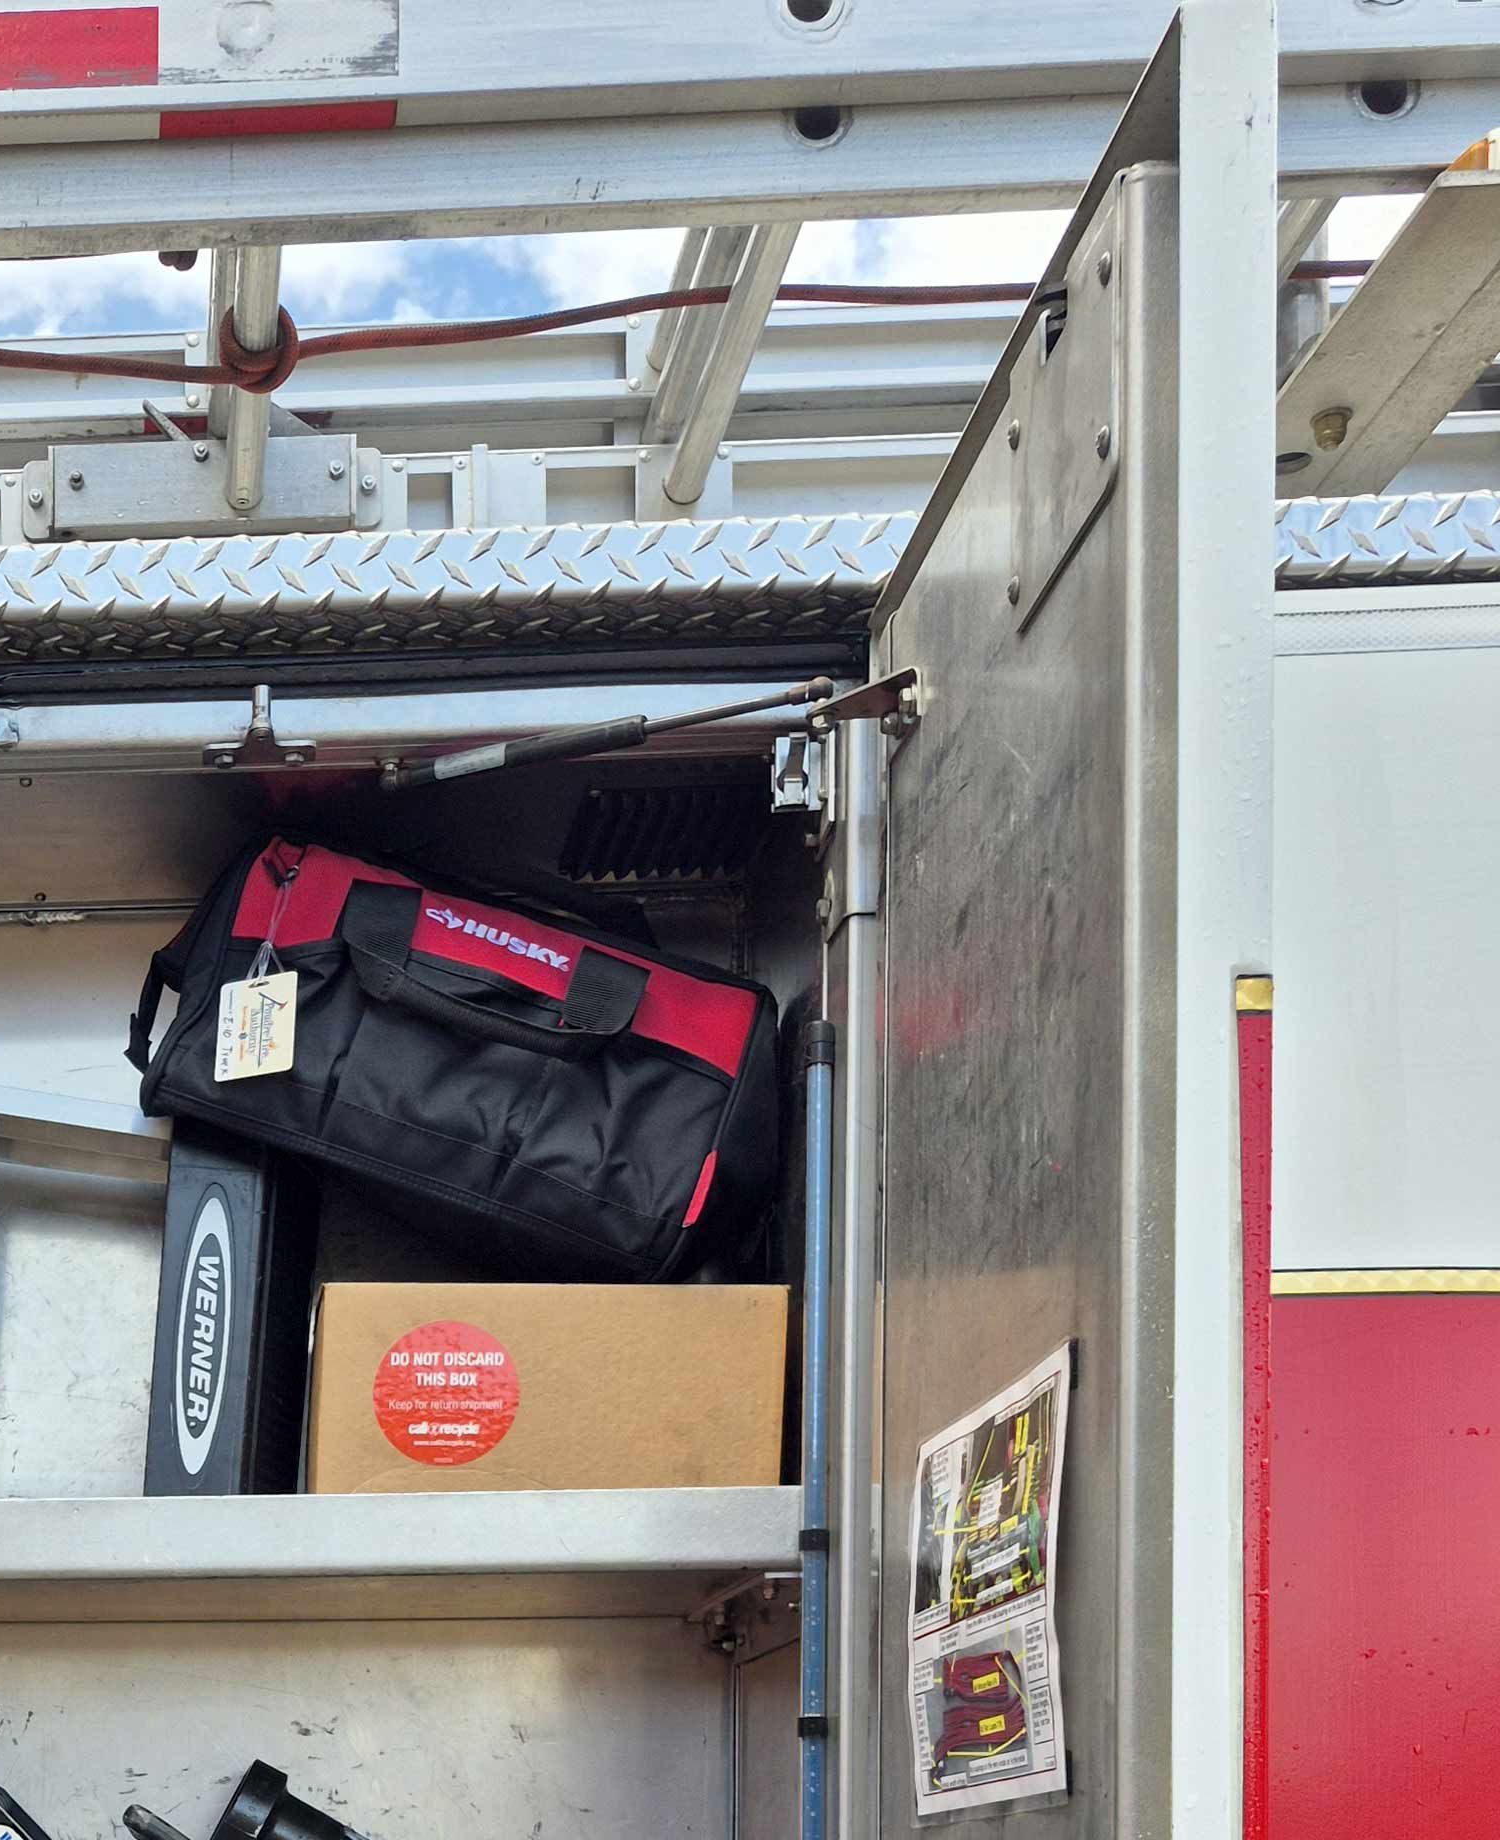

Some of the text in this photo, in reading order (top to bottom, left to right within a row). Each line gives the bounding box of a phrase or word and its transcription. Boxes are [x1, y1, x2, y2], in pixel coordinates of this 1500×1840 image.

[463, 919, 570, 968] HUSKY
[188, 1255, 221, 1426] WERNER
[390, 1352, 505, 1366] DO NOT DISCARD
[415, 1372, 478, 1386] THIS BOX
[388, 1399, 414, 1412] Keep
[414, 1399, 428, 1410] for
[429, 1399, 459, 1410] return
